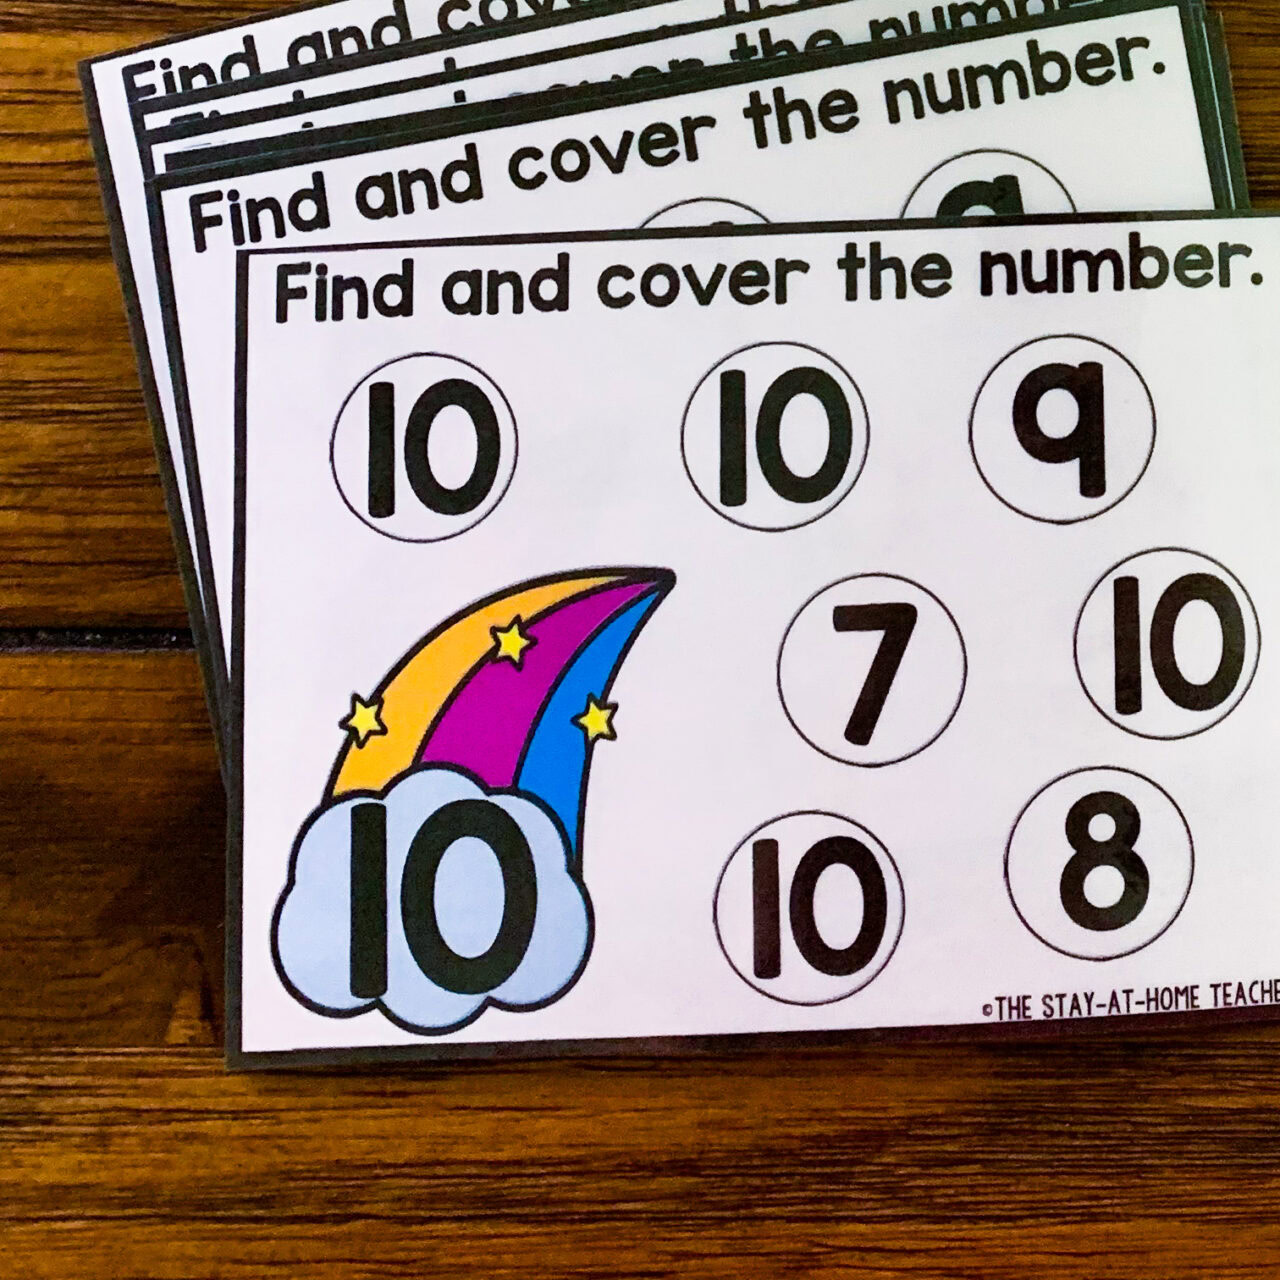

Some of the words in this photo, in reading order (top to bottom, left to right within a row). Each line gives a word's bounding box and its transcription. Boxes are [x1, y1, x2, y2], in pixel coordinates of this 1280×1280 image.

[121, 34, 262, 103] Find
[188, 170, 331, 254] Find
[355, 142, 484, 220] and
[508, 114, 717, 191] cover
[742, 86, 860, 149] the
[882, 36, 1167, 126] number.
[275, 257, 414, 324] Find
[441, 251, 570, 316] and
[598, 258, 811, 309] cover
[837, 241, 953, 302] the
[980, 231, 1264, 297] number.
[368, 379, 501, 519] 10
[720, 367, 853, 507] 10
[833, 602, 918, 746] 7
[1114, 573, 1246, 716] 10
[350, 799, 538, 999] 10
[753, 835, 888, 980] 10
[1060, 790, 1150, 932] 8
[1041, 984, 1200, 1019] STAY-AT-HOME
